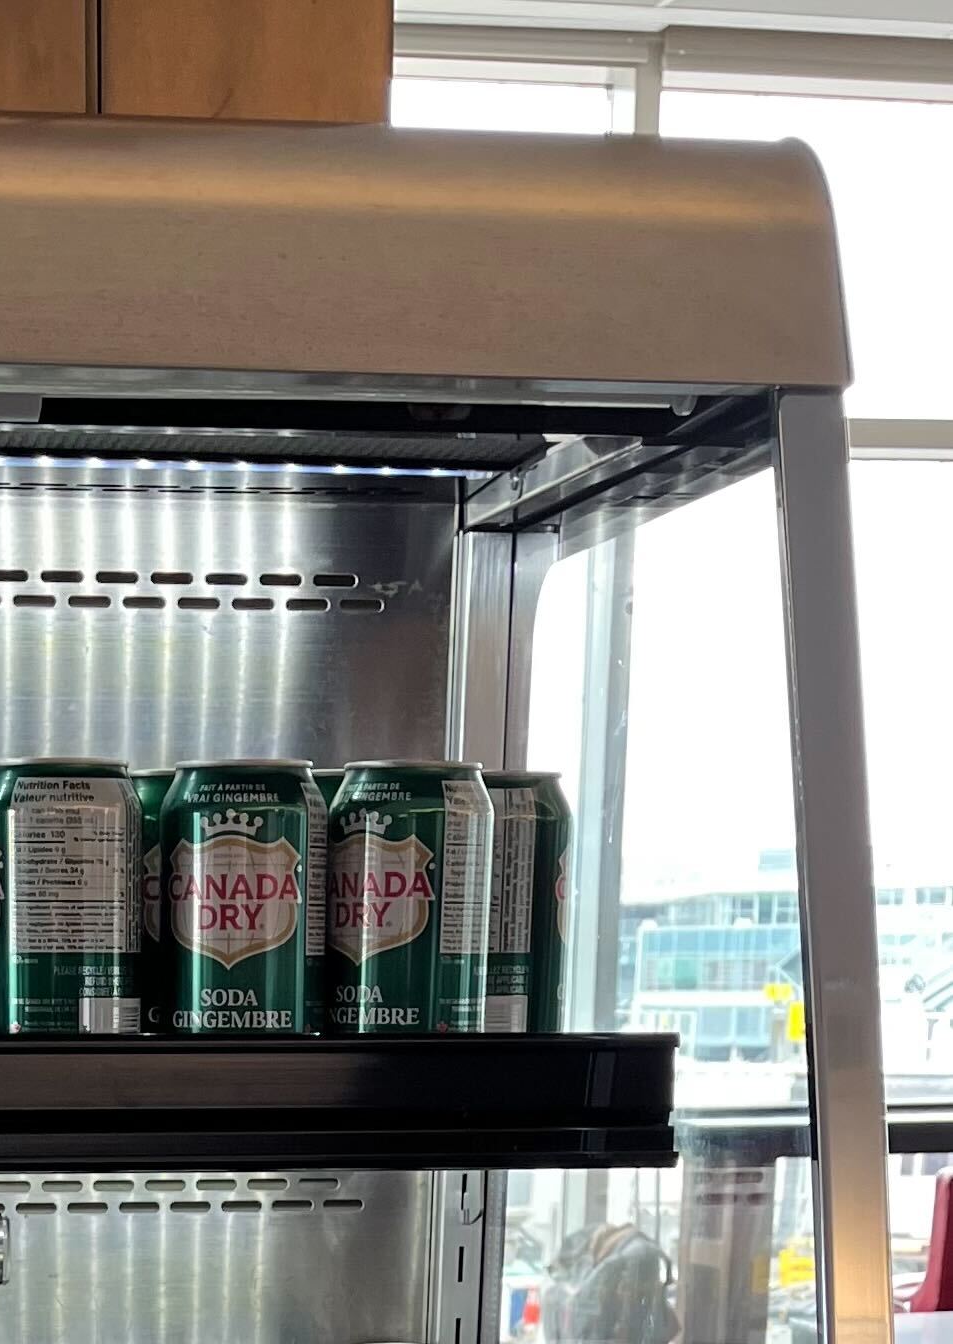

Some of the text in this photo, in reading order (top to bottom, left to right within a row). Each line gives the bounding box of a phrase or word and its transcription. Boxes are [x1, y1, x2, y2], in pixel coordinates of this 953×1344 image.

[17, 780, 92, 791] Nutrition Facts
[49, 793, 95, 804] nutritive
[213, 793, 279, 802] GINGEMBRE
[169, 873, 297, 900] CANADA
[329, 871, 432, 898] ANADA
[197, 904, 264, 931] DRY
[335, 902, 391, 928] DRY
[201, 988, 259, 1006] SODA
[335, 985, 384, 1003] SODA
[172, 1010, 292, 1029] GINGEMBRE
